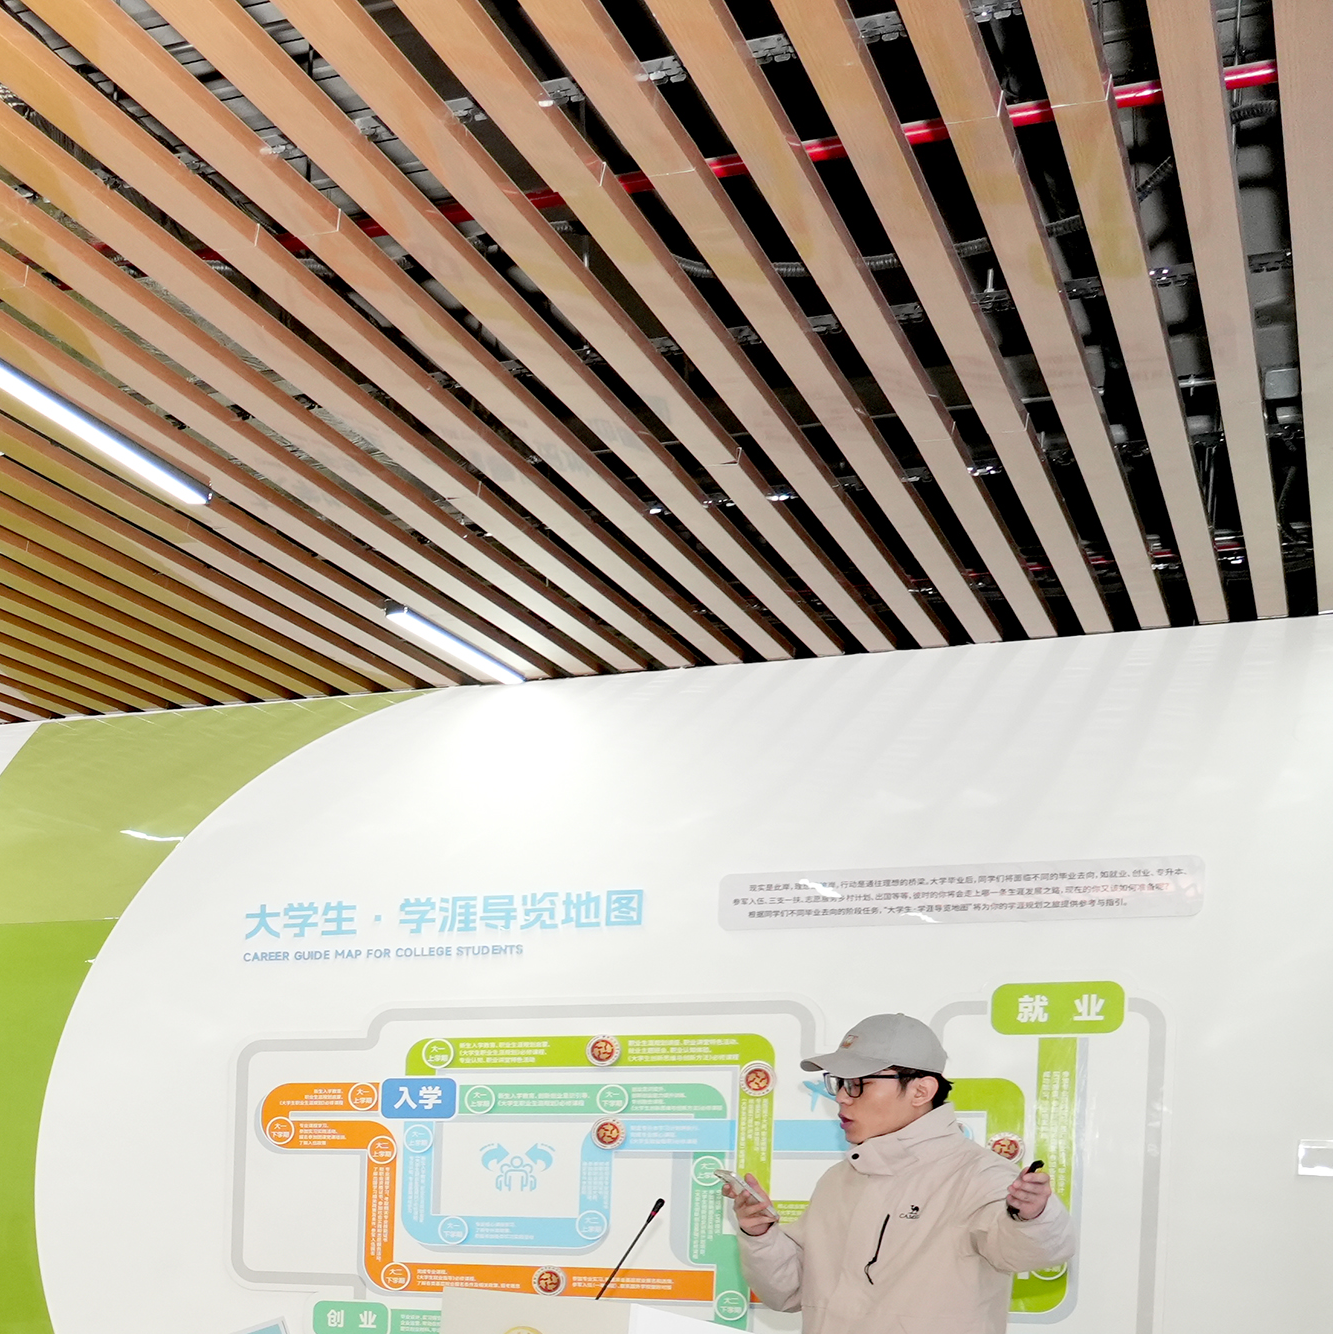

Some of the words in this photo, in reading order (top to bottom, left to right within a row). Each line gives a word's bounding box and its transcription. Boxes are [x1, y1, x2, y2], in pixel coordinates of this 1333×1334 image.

[243, 951, 290, 962] CAREER
[294, 950, 330, 961] GUIDE
[334, 949, 363, 960] MAP
[367, 948, 390, 958] FOR
[395, 946, 452, 958] COLLEGE
[456, 944, 524, 956] STUDENTS
[1016, 993, 1105, 1024] 就业
[427, 1054, 448, 1062] 上学期
[356, 1088, 370, 1096] 大一
[394, 1086, 442, 1110] 入学
[327, 1309, 377, 1328] 创业
